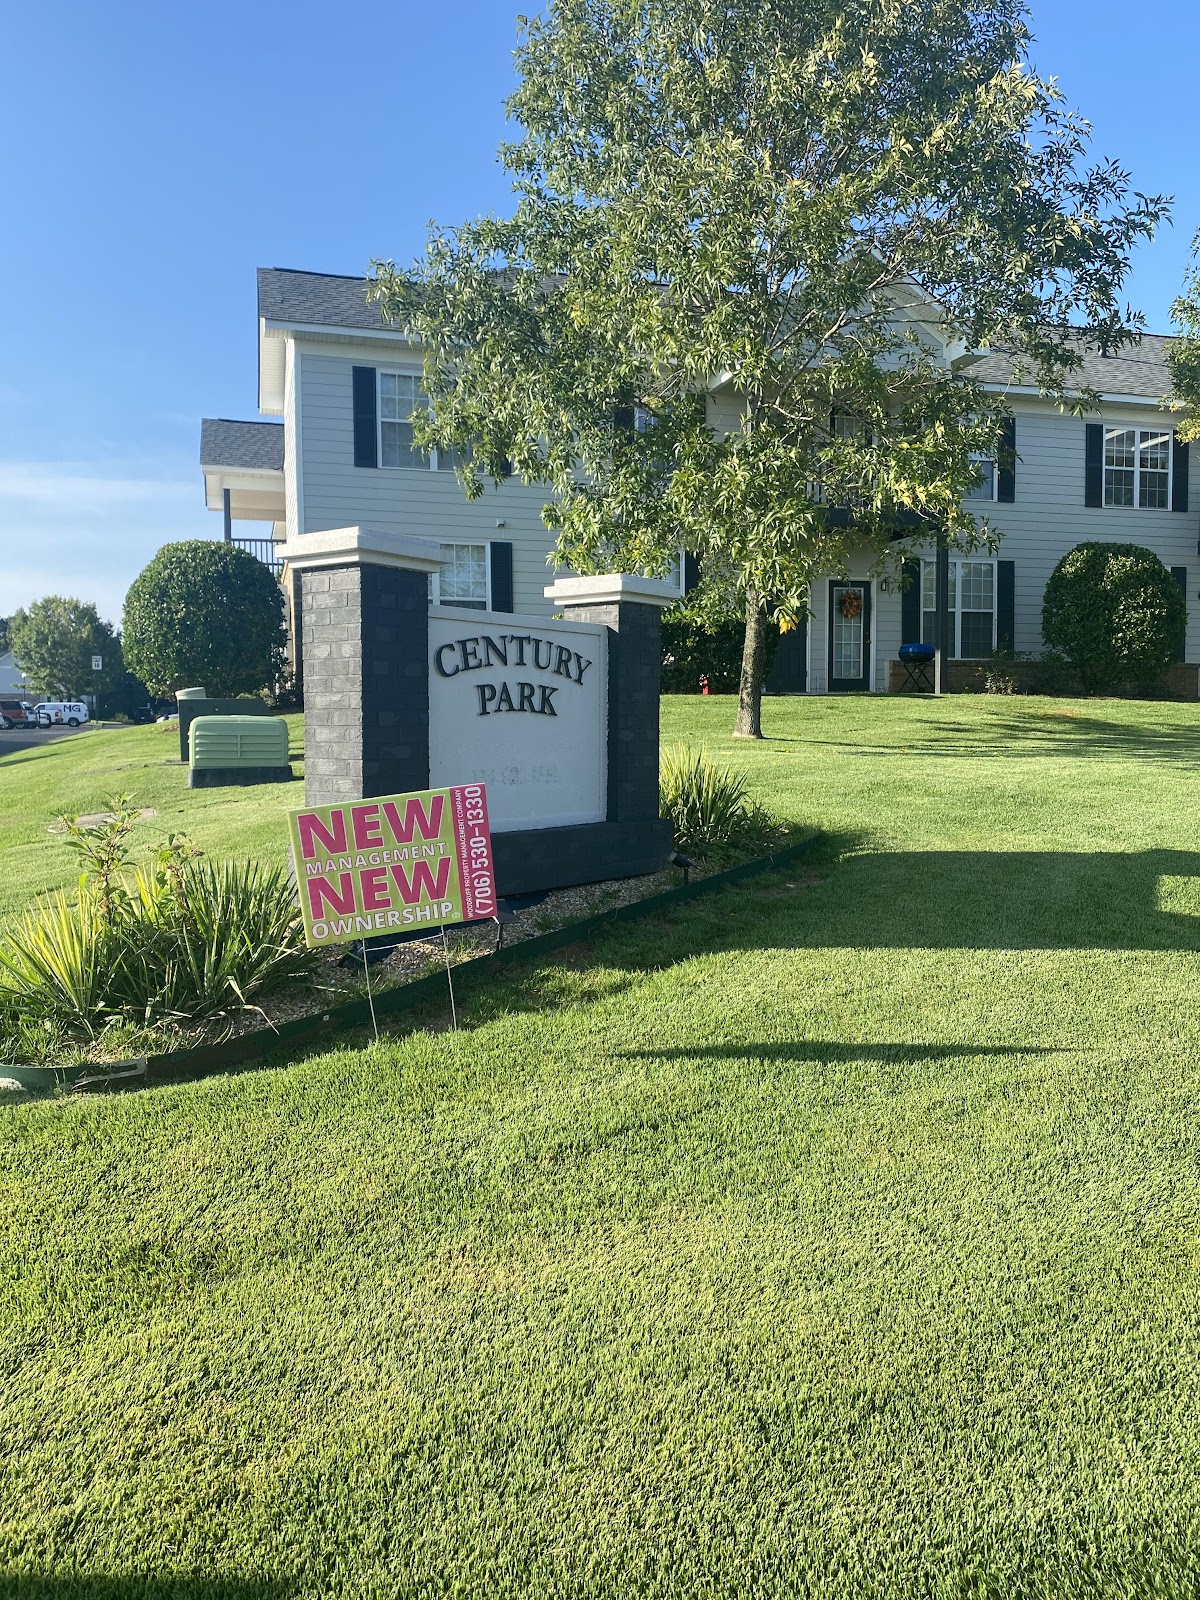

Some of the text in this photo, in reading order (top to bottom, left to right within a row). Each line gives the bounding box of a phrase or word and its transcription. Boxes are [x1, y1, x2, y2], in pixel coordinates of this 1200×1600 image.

[435, 634, 592, 686] CENTURY
[63, 704, 81, 712] MG
[475, 681, 559, 716] PARK
[455, 790, 463, 818] COMPANY
[297, 794, 446, 859] NEW
[458, 819, 467, 858] MANAGEMENT
[306, 842, 447, 876] MANAGEMENT
[306, 856, 452, 921] NEW
[465, 888, 473, 918] WOODRUFF
[312, 901, 453, 940] OWNERSHIP
